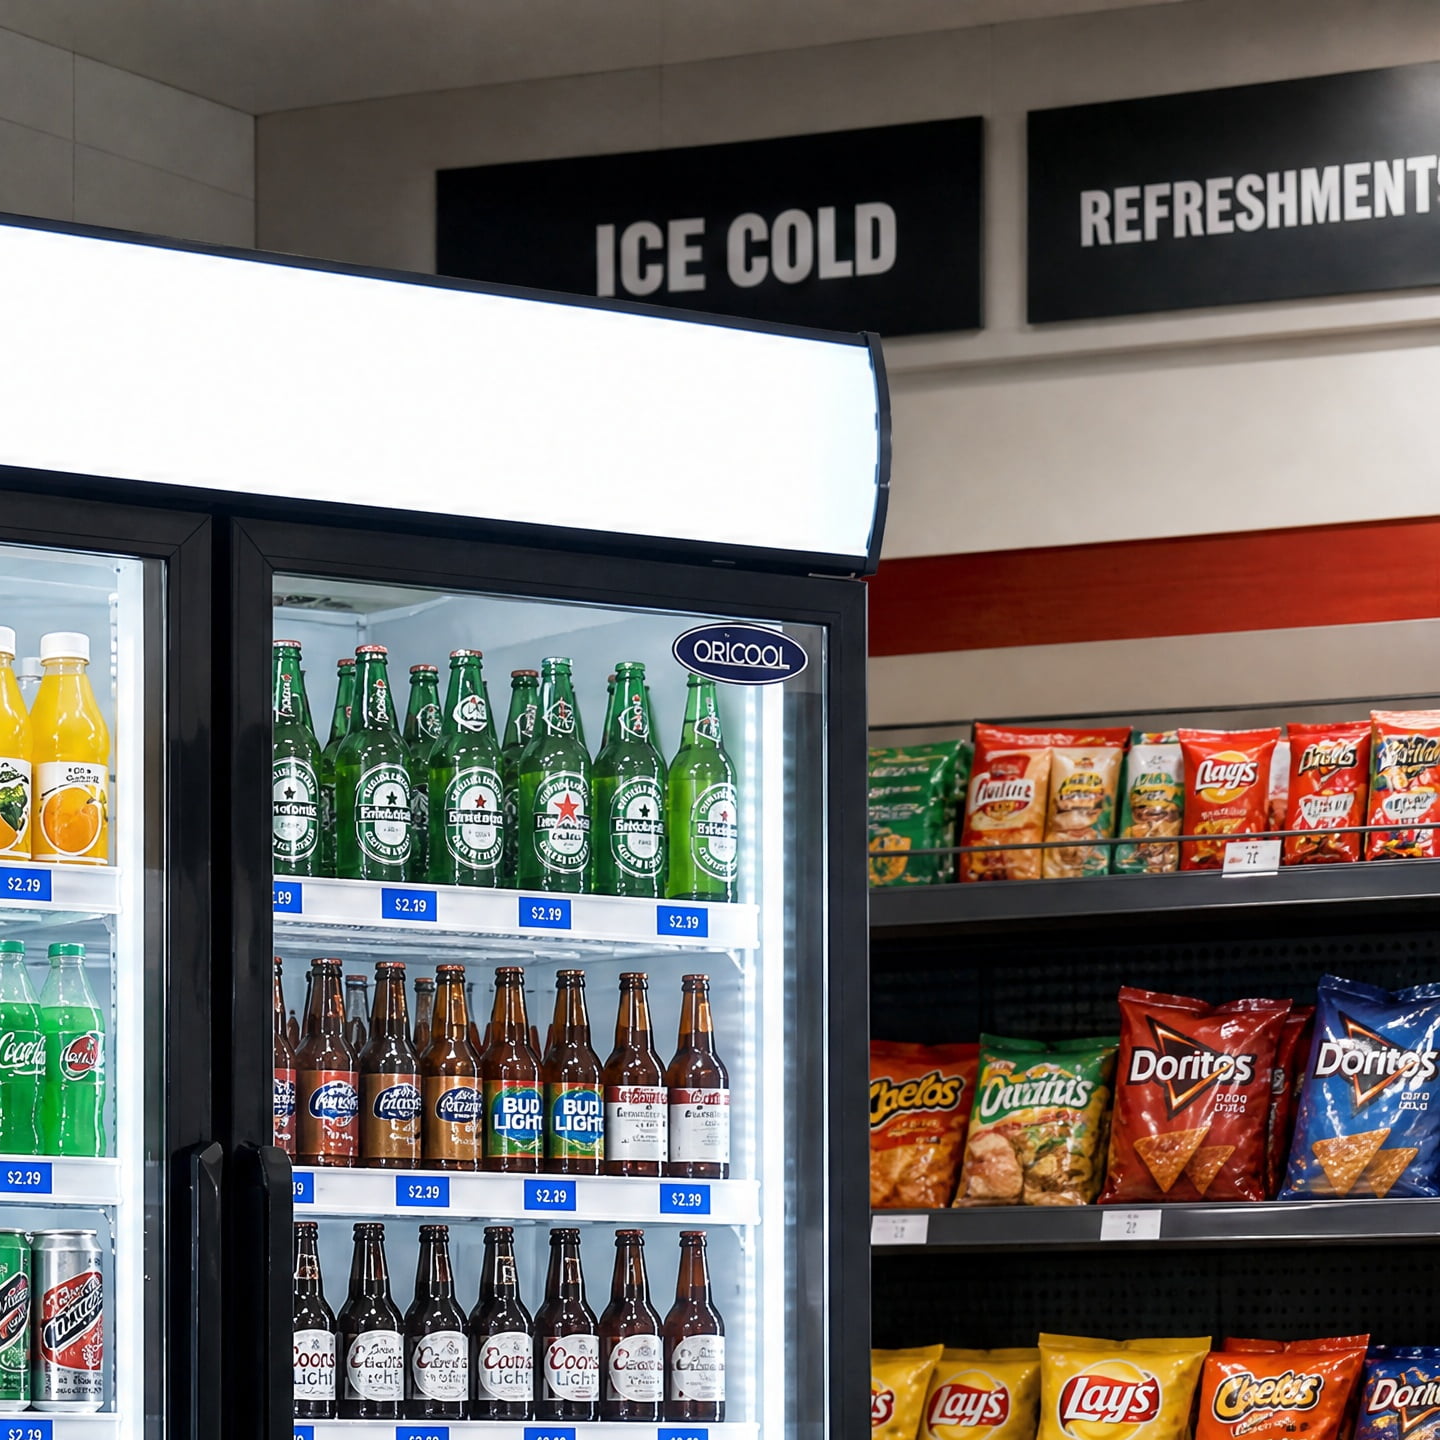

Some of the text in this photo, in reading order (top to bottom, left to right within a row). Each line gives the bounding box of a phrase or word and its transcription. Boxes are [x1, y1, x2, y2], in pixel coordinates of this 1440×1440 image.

[1081, 154, 1440, 247] REFRESHMENT
[595, 201, 898, 298] ICE COLD
[693, 639, 789, 669] ORICOOL
[1129, 1050, 1254, 1082] Doritos
[1316, 1042, 1439, 1079] Doritos
[503, 1097, 540, 1113] BUD
[563, 1099, 600, 1115] BUD
